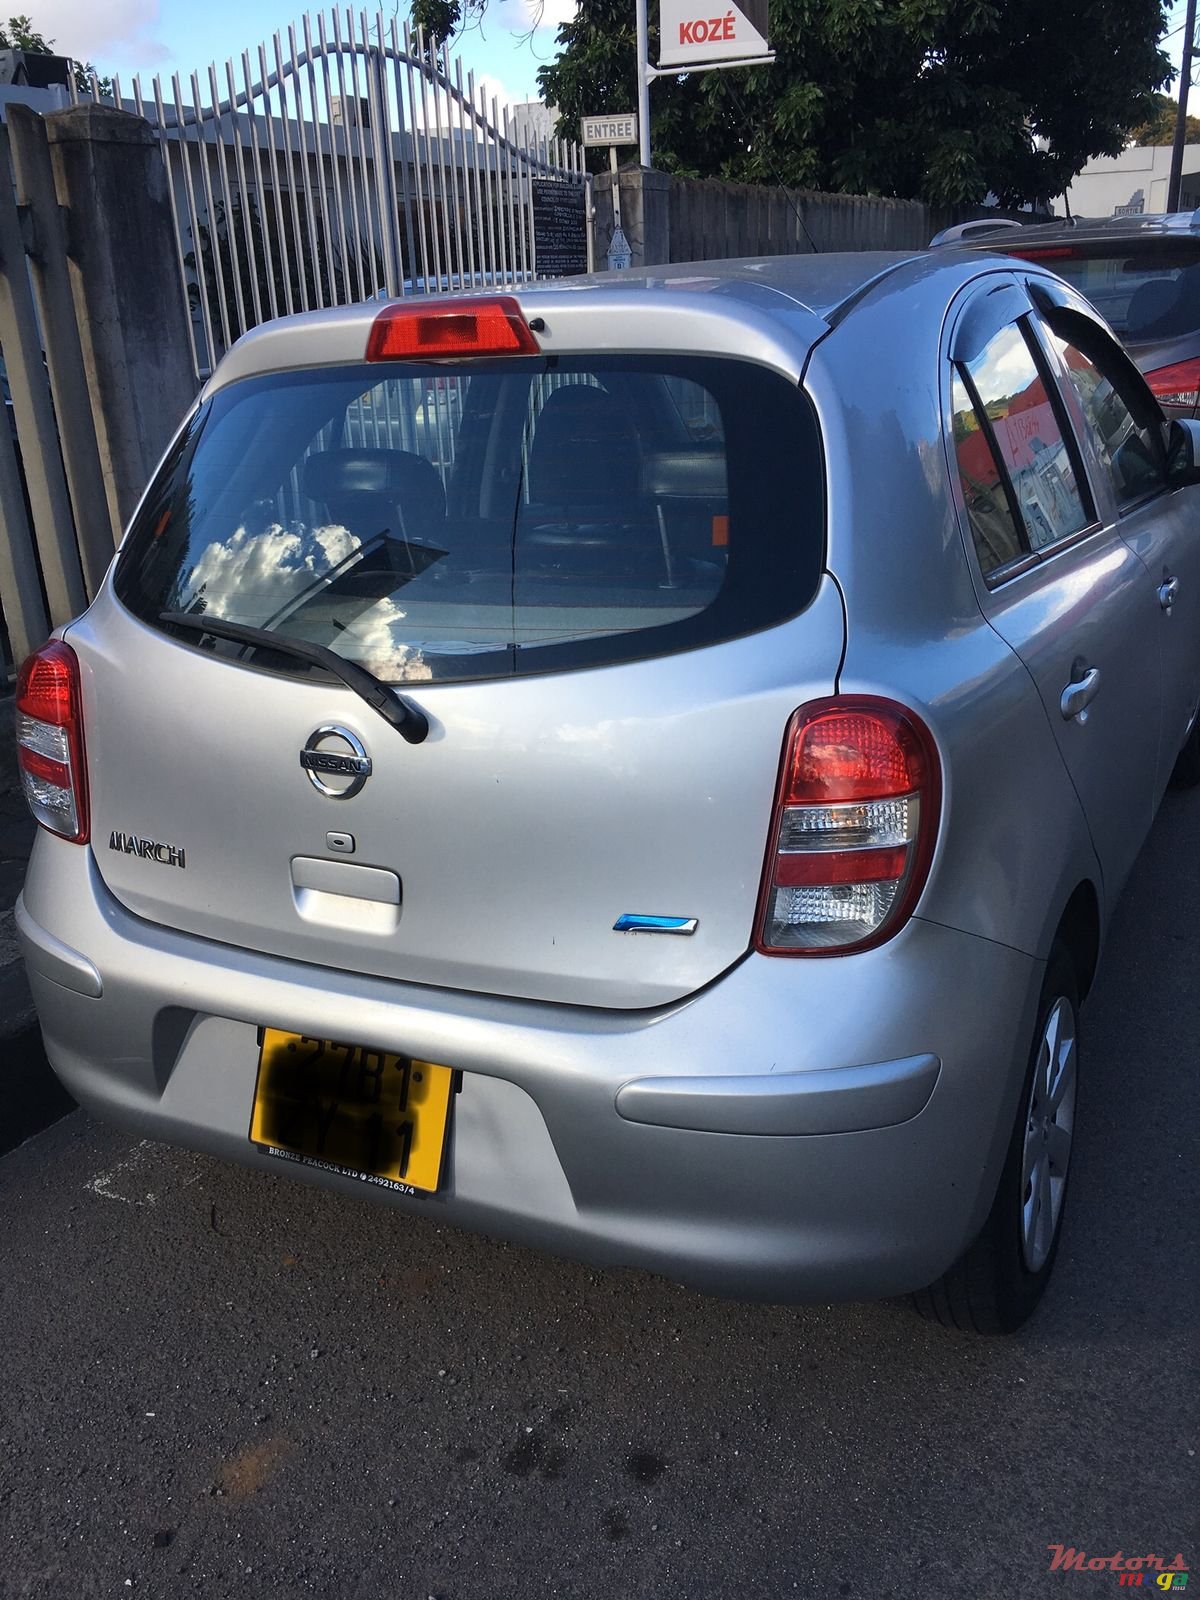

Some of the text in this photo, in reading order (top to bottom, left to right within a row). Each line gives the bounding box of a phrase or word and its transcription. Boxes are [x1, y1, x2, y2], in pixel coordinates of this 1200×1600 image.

[679, 10, 736, 45] KOZÉ
[586, 122, 632, 139] ENTREE
[303, 752, 362, 774] NISSAN
[109, 831, 186, 869] MARCH
[268, 1146, 416, 1196] BRONZE PEACOCK LTD 2492163/4
